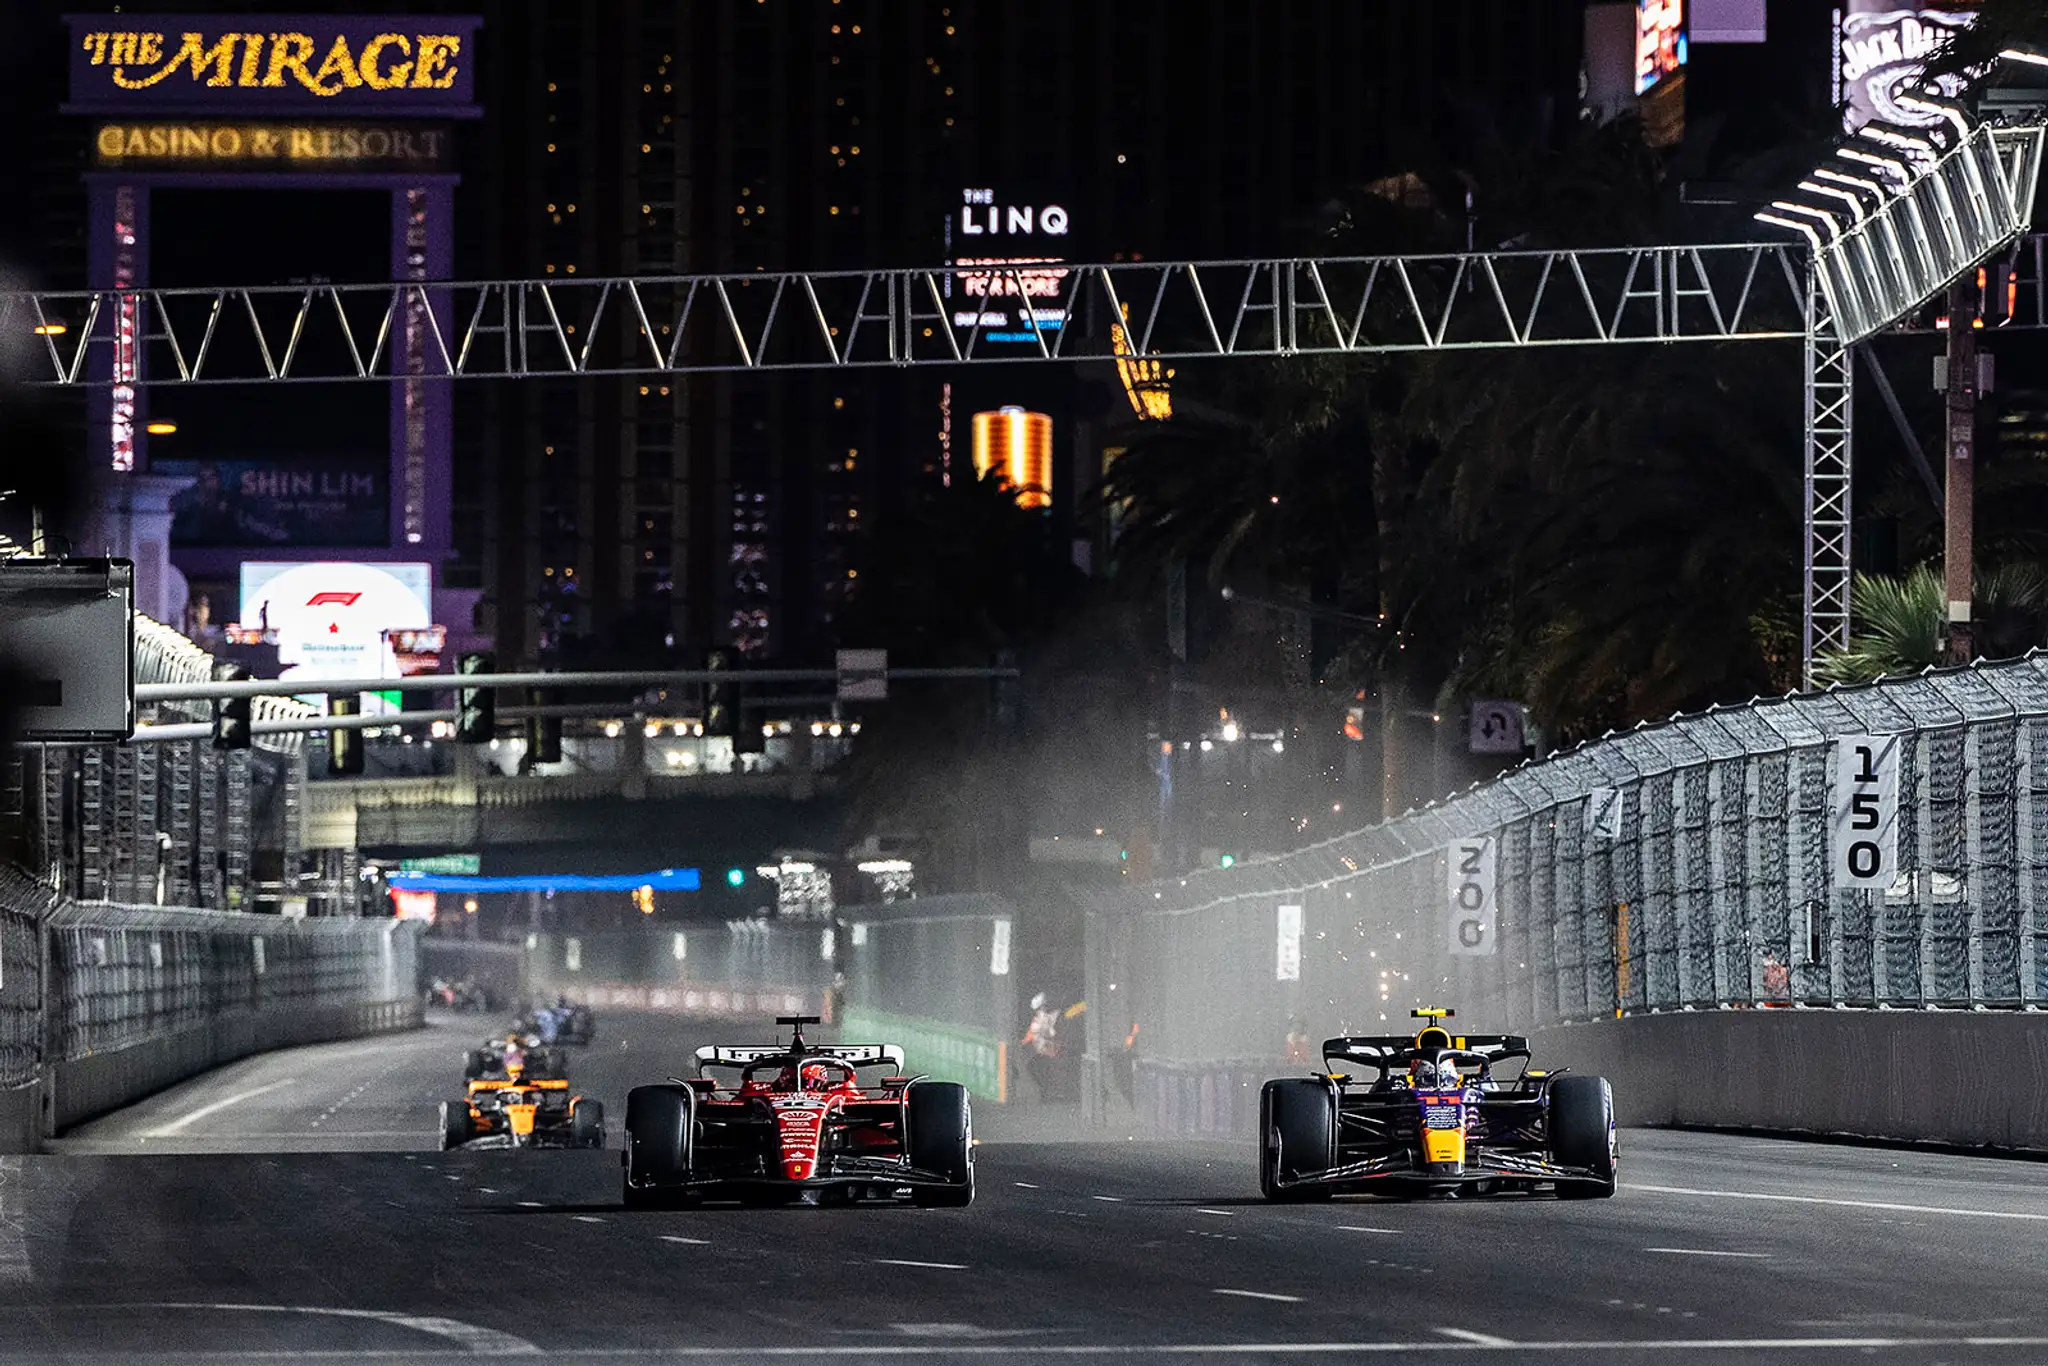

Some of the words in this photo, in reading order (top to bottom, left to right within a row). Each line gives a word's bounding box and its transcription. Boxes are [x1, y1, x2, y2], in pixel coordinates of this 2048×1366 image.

[83, 32, 163, 65] THE
[113, 32, 461, 96] MIRAGE
[1841, 29, 1902, 80] JACK
[97, 126, 241, 157] CASINO
[249, 129, 279, 157] &
[291, 127, 443, 158] RESORT
[963, 188, 994, 204] THE
[962, 205, 1068, 235] LINQ
[240, 471, 313, 497] SHIN
[320, 472, 373, 497] LIM
[1847, 746, 1881, 878] 150
[1458, 847, 1484, 948] 200
